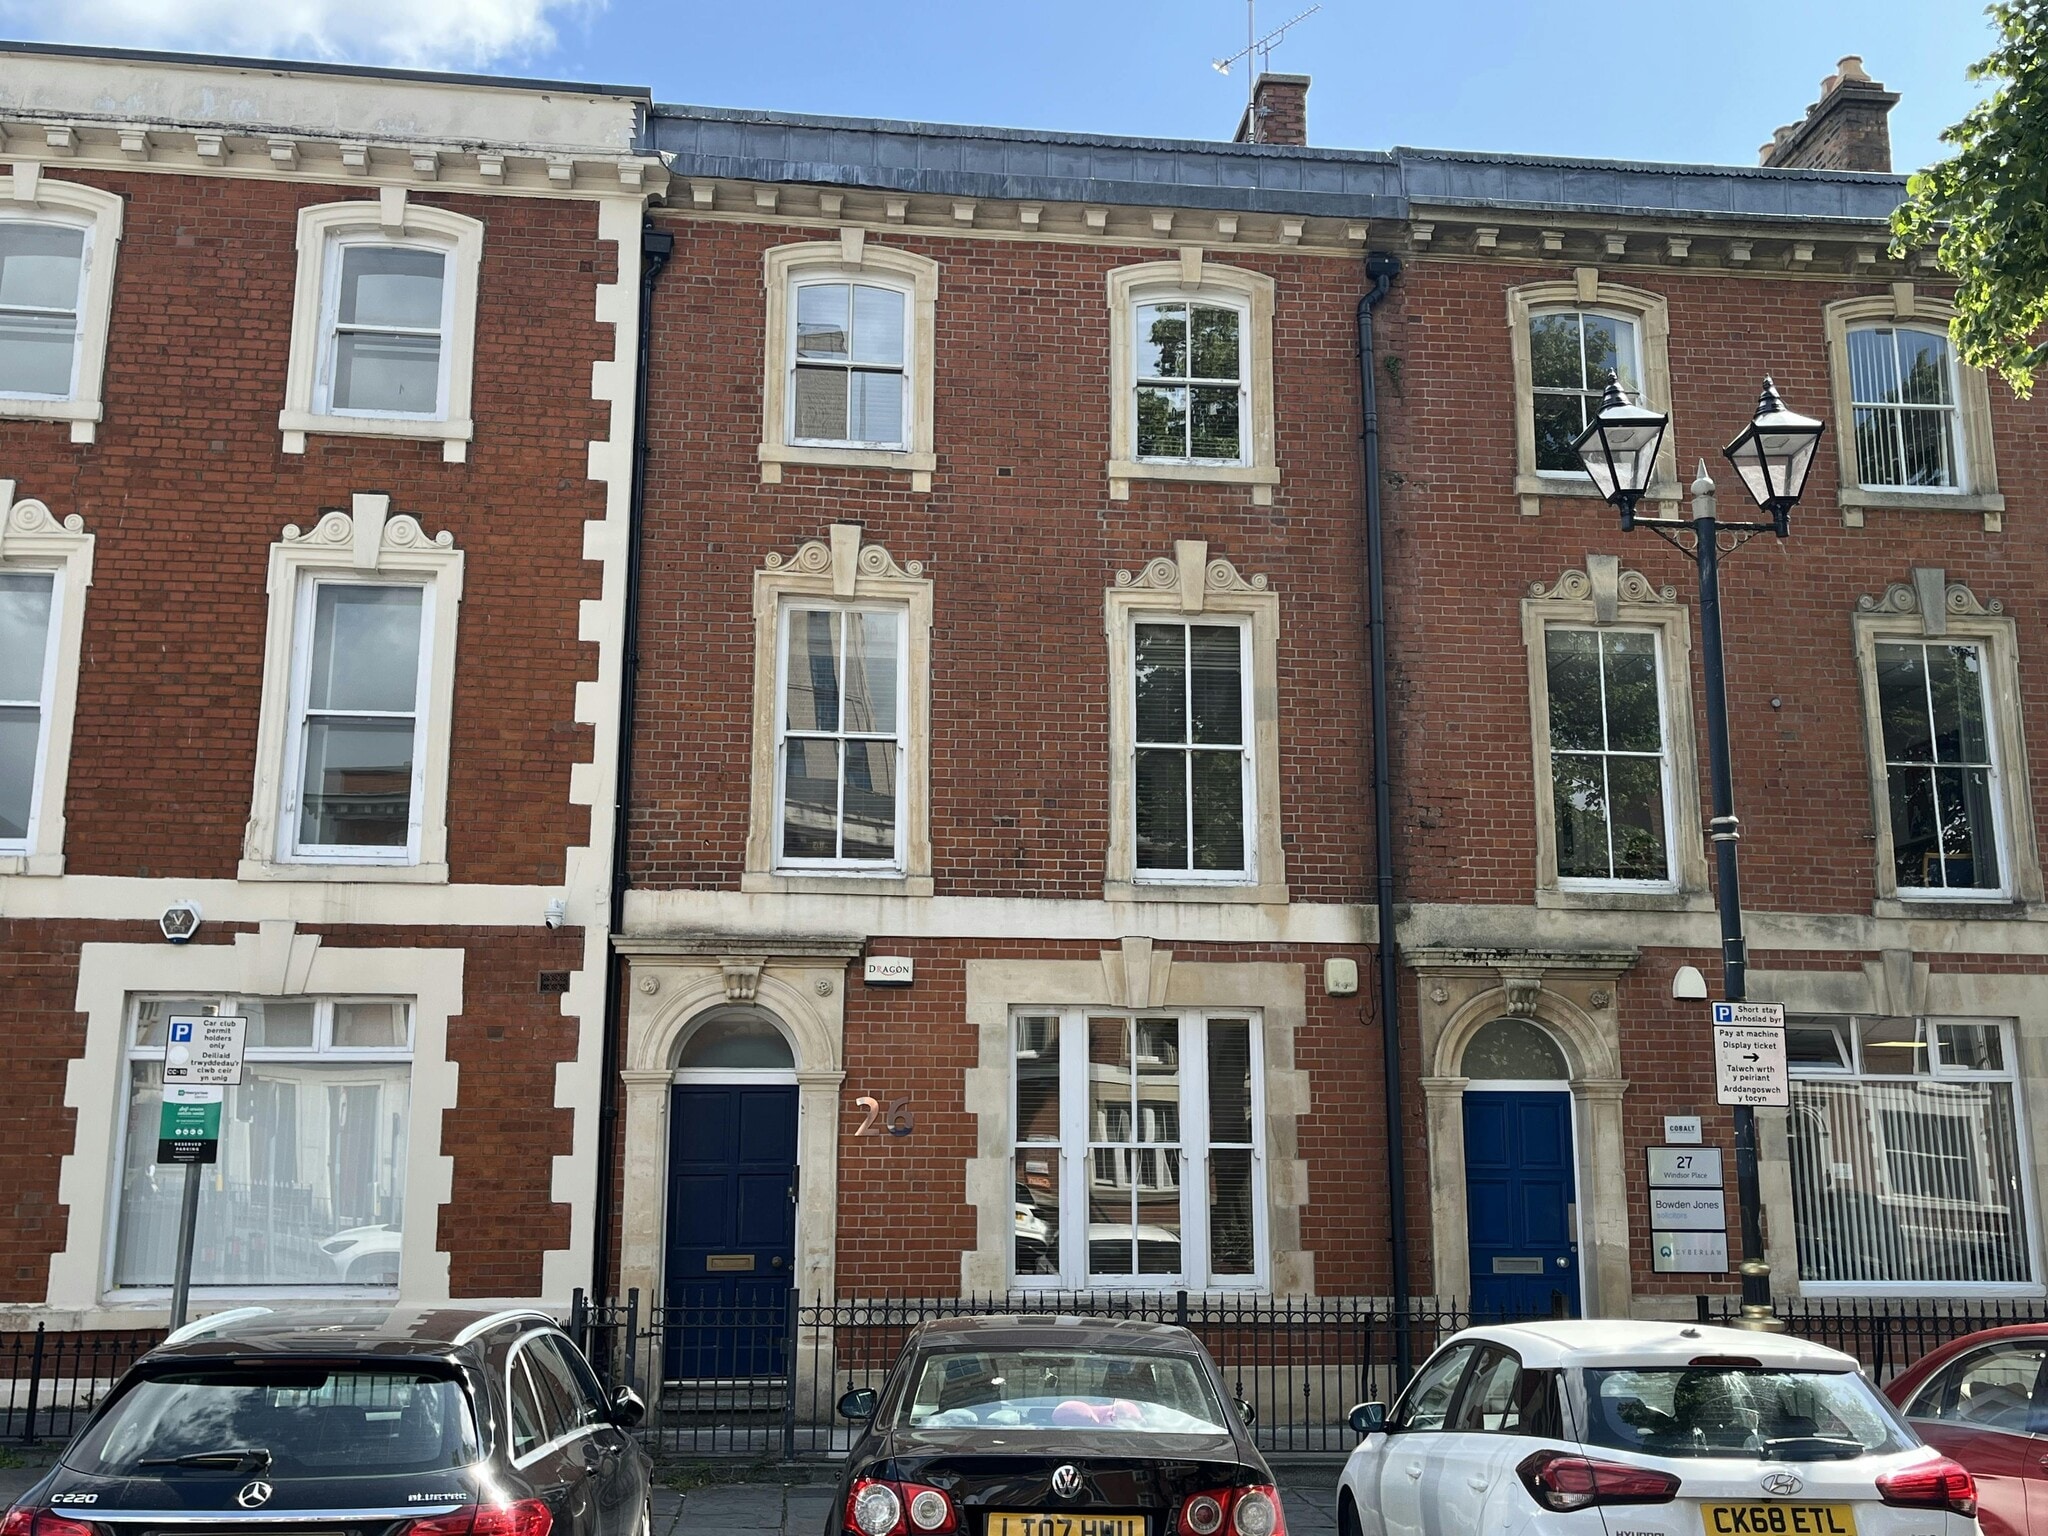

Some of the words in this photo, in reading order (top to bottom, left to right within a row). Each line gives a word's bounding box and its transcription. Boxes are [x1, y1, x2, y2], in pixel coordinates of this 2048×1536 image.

[869, 965, 909, 974] DRAGON
[1720, 1007, 1730, 1020] P
[1762, 1007, 1777, 1015] stay
[1770, 1016, 1781, 1024] byr
[174, 1025, 189, 1041] P
[1719, 1029, 1733, 1037] Pay
[1746, 1030, 1779, 1038] machine
[1723, 1041, 1751, 1050] Display
[1723, 1085, 1781, 1094] Arddangoswch
[854, 1096, 914, 1137] 26
[1676, 1156, 1693, 1169] 27
[1656, 1200, 1690, 1209] Bowden
[1693, 1201, 1719, 1209] Jones
[50, 1493, 99, 1503] C220
[1713, 1507, 1788, 1534] CK68
[1794, 1507, 1846, 1534] ETL
